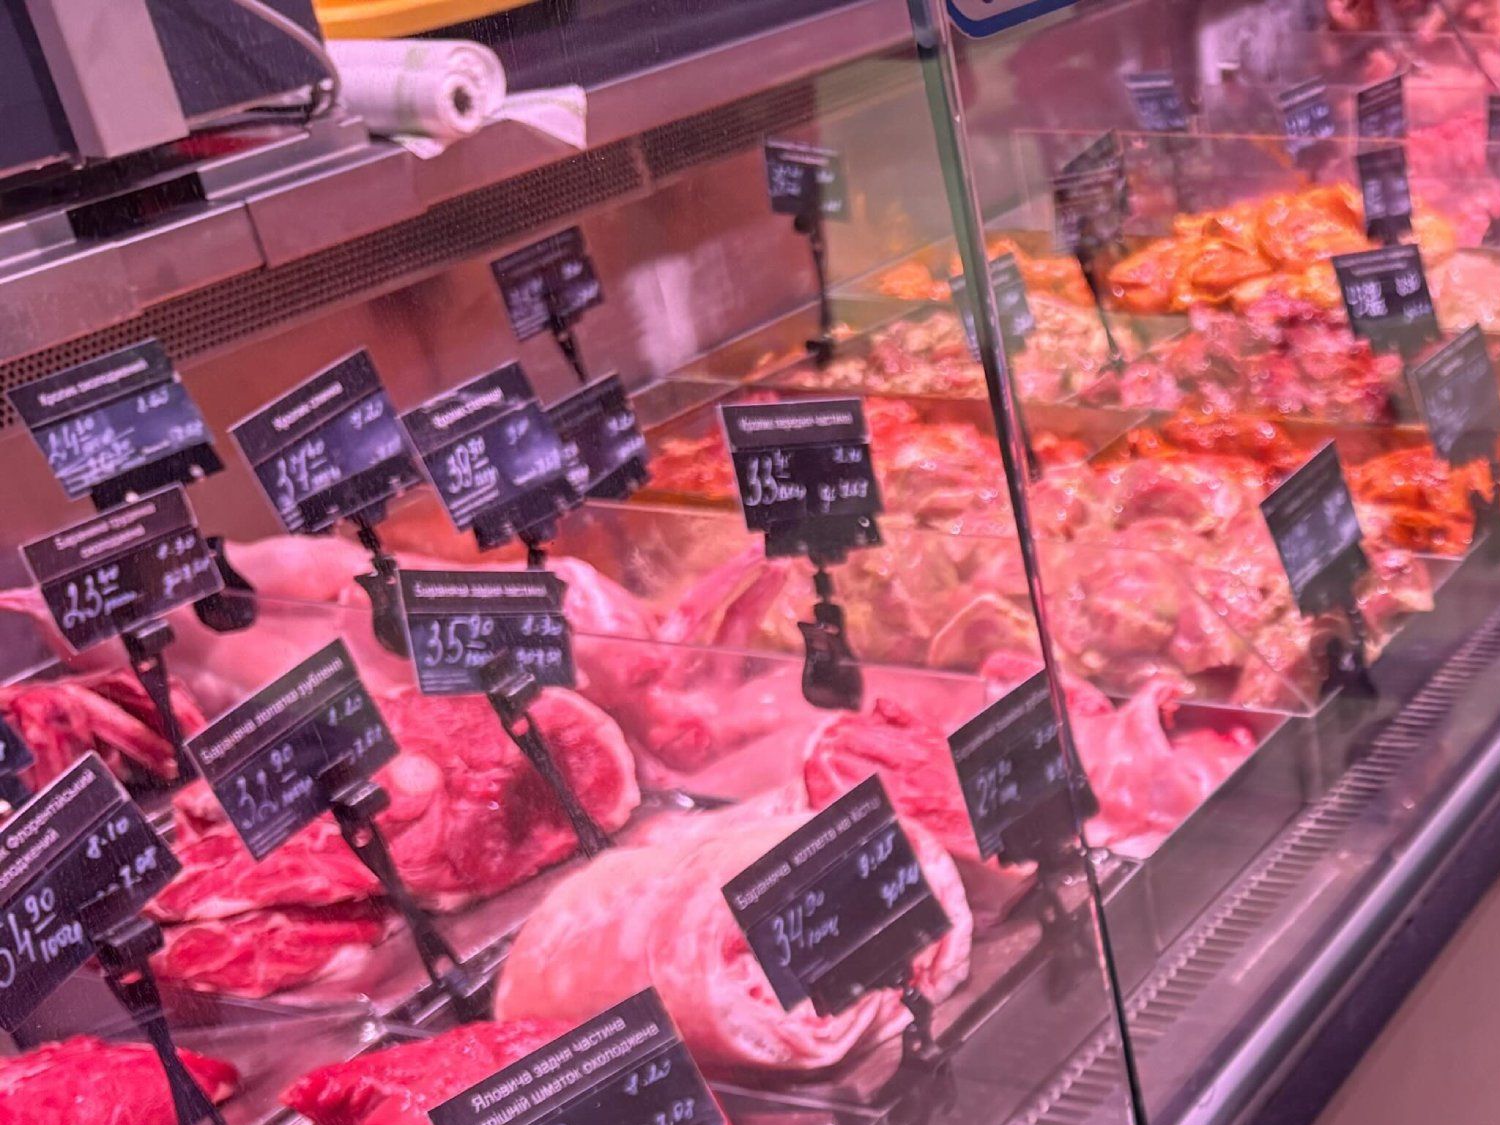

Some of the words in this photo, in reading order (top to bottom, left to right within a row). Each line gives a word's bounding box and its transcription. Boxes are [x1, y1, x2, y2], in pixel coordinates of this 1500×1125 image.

[25, 887, 55, 923] 90
[470, 1066, 534, 1115] Яловича
[532, 1046, 572, 1079] задня
[570, 1015, 627, 1057] частина
[529, 1071, 584, 1105] шматок
[581, 1021, 661, 1075] охолоджена
